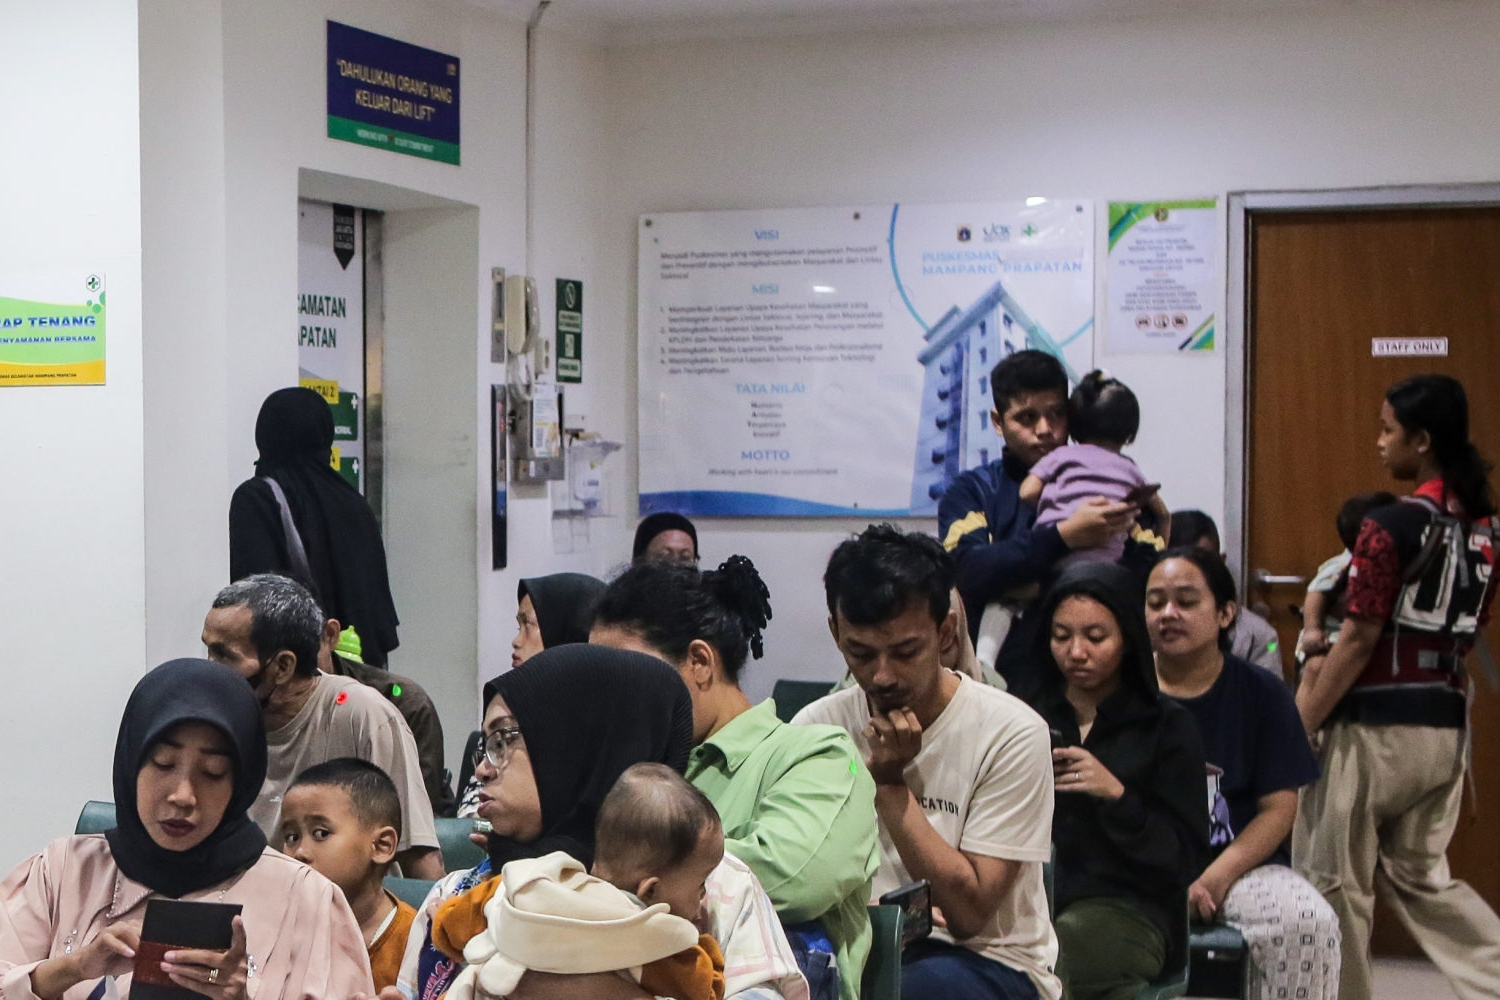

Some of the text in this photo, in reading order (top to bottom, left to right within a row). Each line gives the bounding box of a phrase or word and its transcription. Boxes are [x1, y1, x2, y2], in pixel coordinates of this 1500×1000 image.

[398, 75, 428, 98] ORANG
[429, 84, 452, 104] YANG
[355, 88, 391, 112] KELUAR
[392, 97, 413, 116] DARI
[755, 230, 779, 240] VISI
[922, 262, 1083, 275] MAMPANG PRAPATAN
[752, 284, 779, 294] MISI
[298, 293, 346, 318] AMATAN
[28, 315, 96, 328] TENANG
[1378, 341, 1440, 352] STAFF ONLY
[735, 382, 806, 394] TATA NILAI
[741, 450, 790, 461] MOTTO
